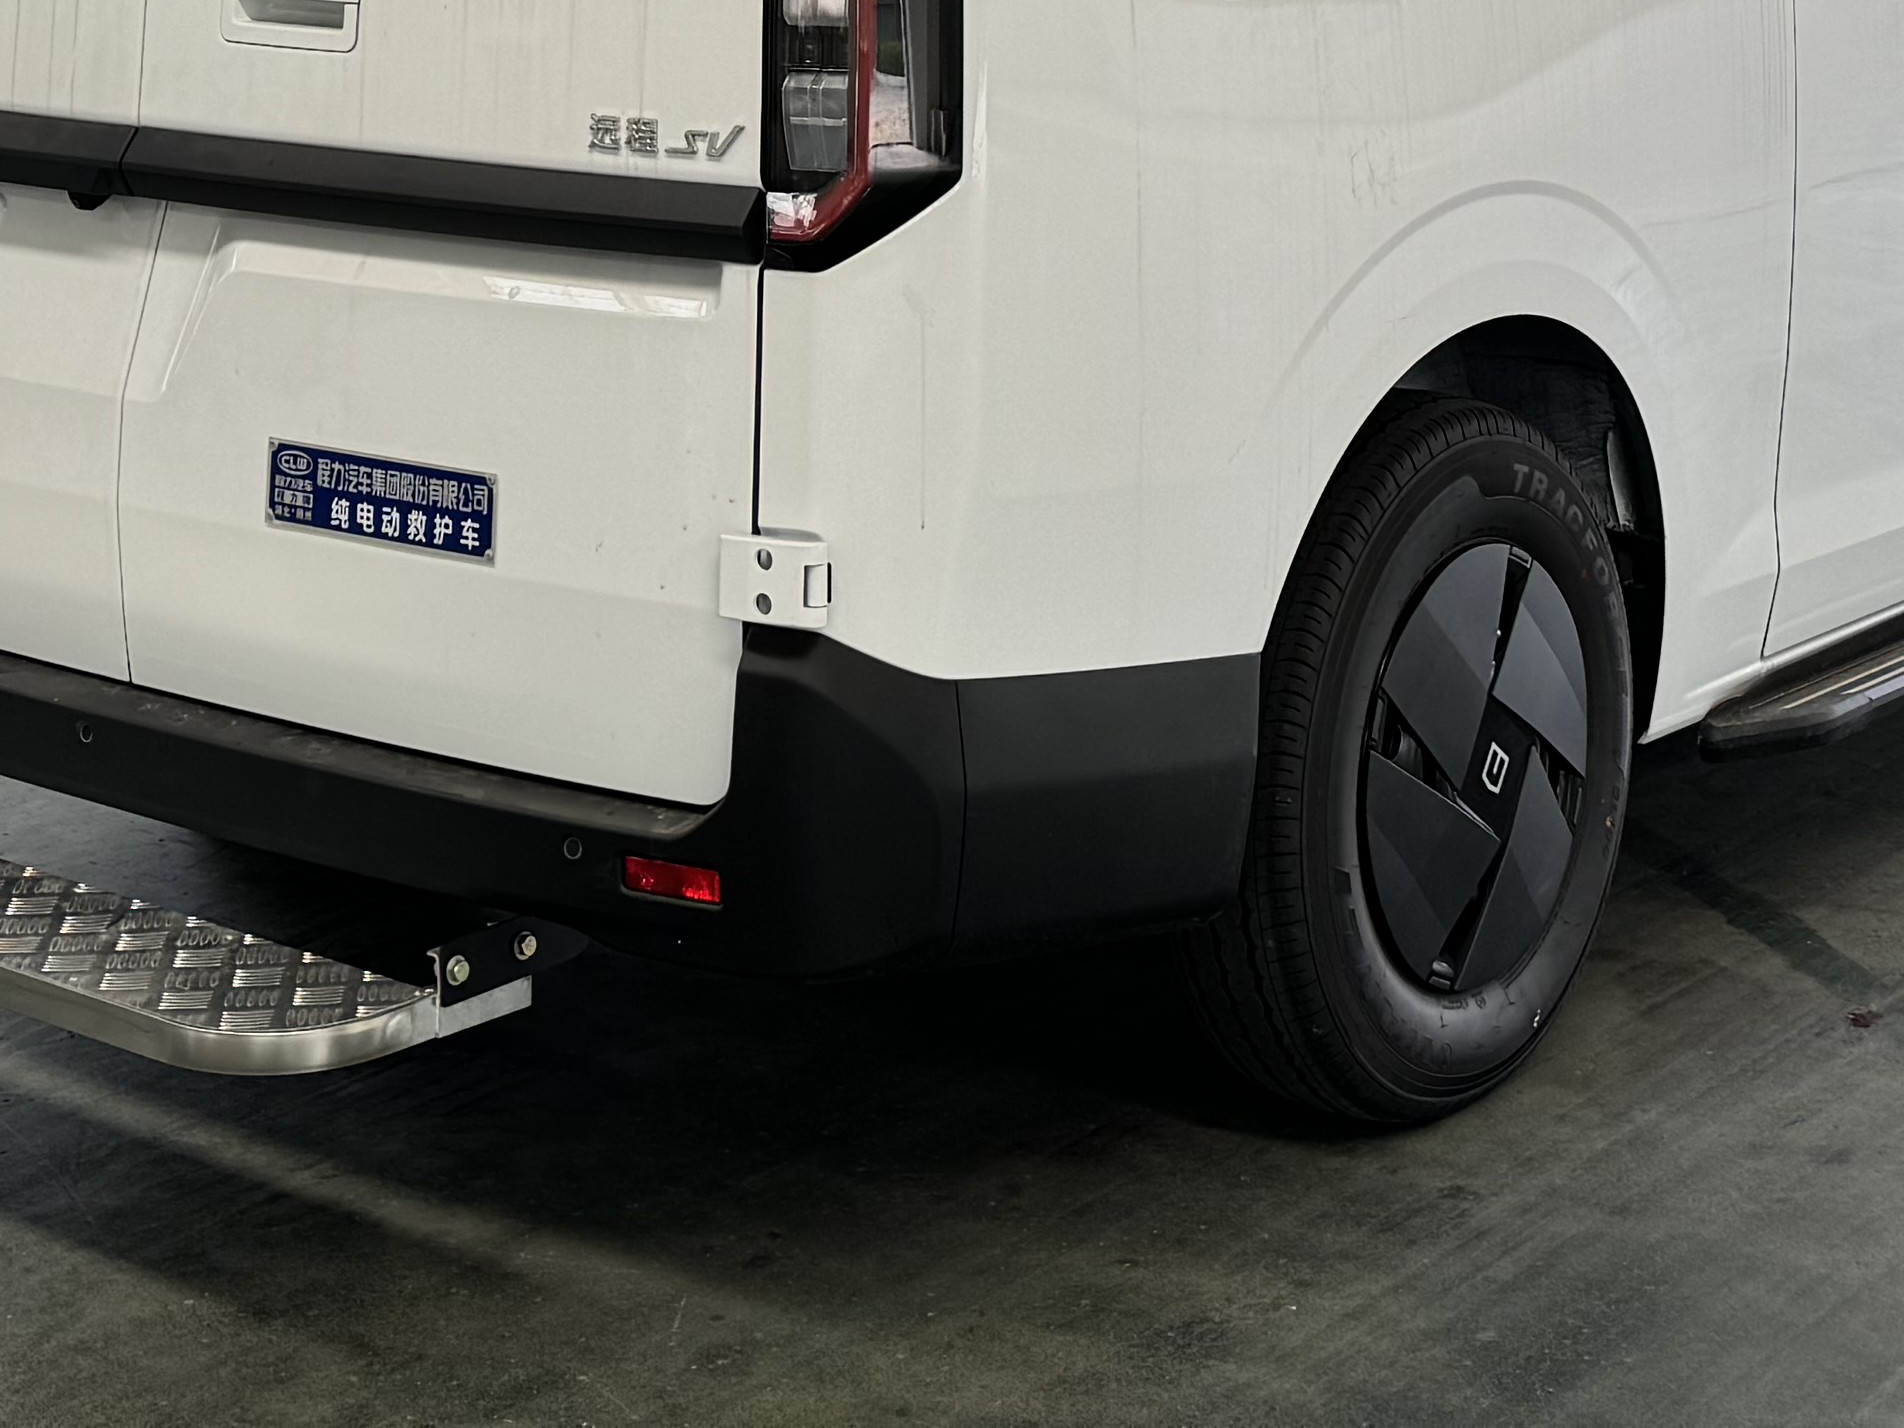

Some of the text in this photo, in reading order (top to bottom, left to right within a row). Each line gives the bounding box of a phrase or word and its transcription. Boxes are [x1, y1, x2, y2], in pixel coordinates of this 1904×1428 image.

[281, 455, 308, 470] CLW
[316, 458, 489, 516] 程力汽车集团股份有限公司
[330, 496, 481, 551] 纯电动救护车
